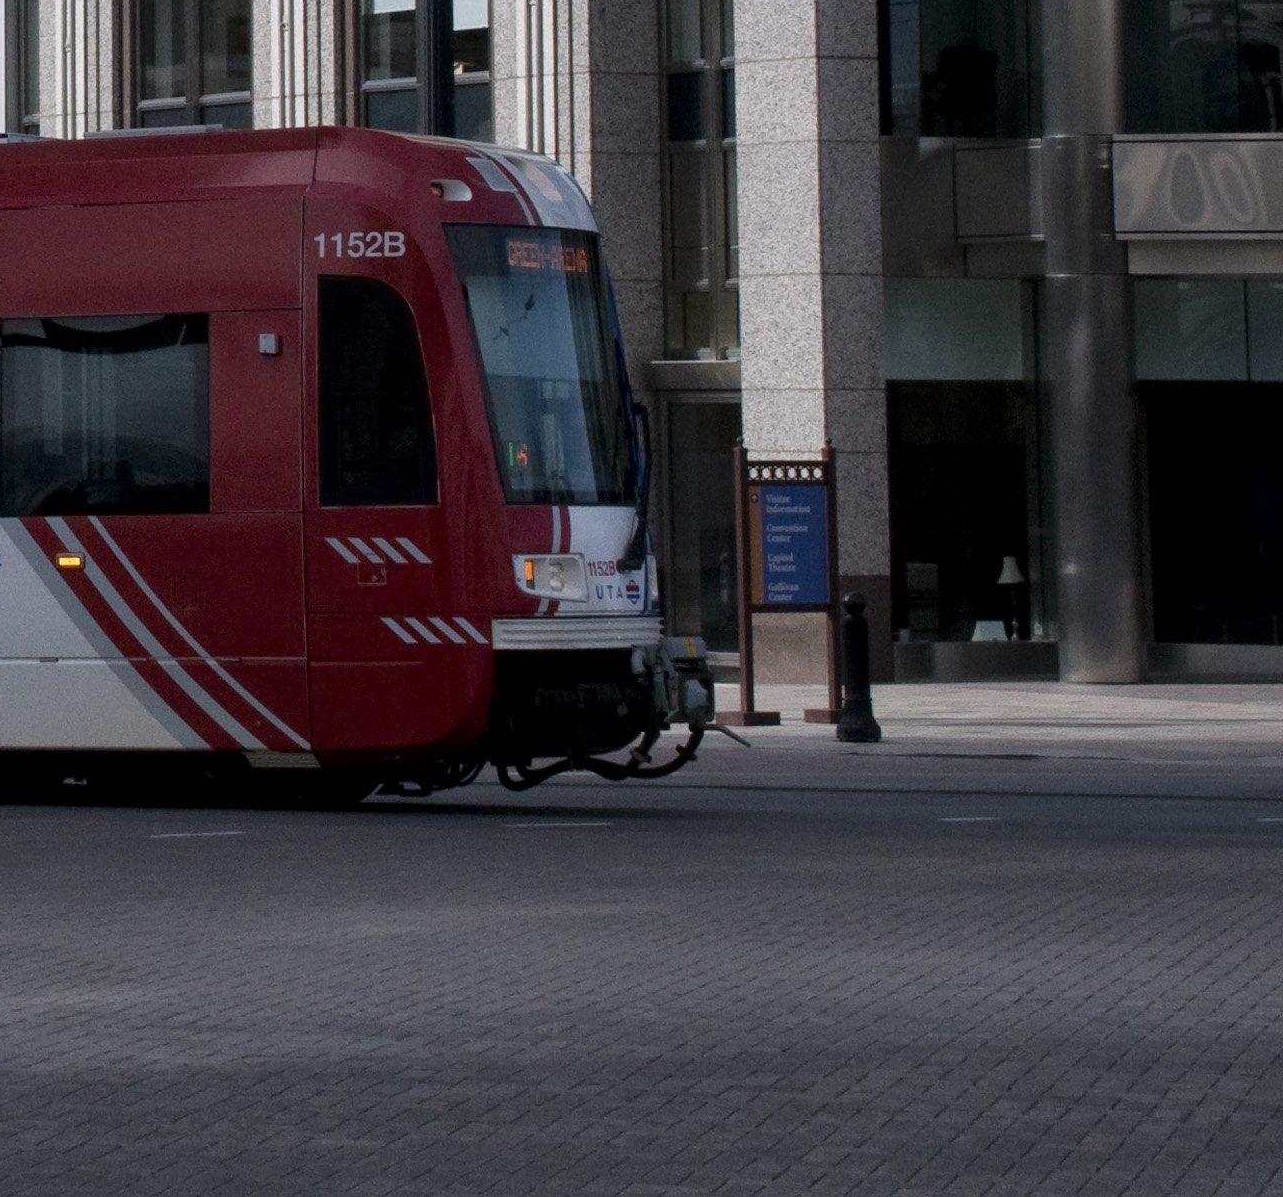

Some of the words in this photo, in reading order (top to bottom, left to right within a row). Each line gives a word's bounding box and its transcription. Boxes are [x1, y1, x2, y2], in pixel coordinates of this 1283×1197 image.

[314, 231, 406, 258] 1152B
[766, 504, 810, 513] Information
[766, 524, 808, 533] Convention
[767, 534, 791, 543] Center
[587, 560, 616, 577] 1152B
[595, 585, 623, 600] UTA
